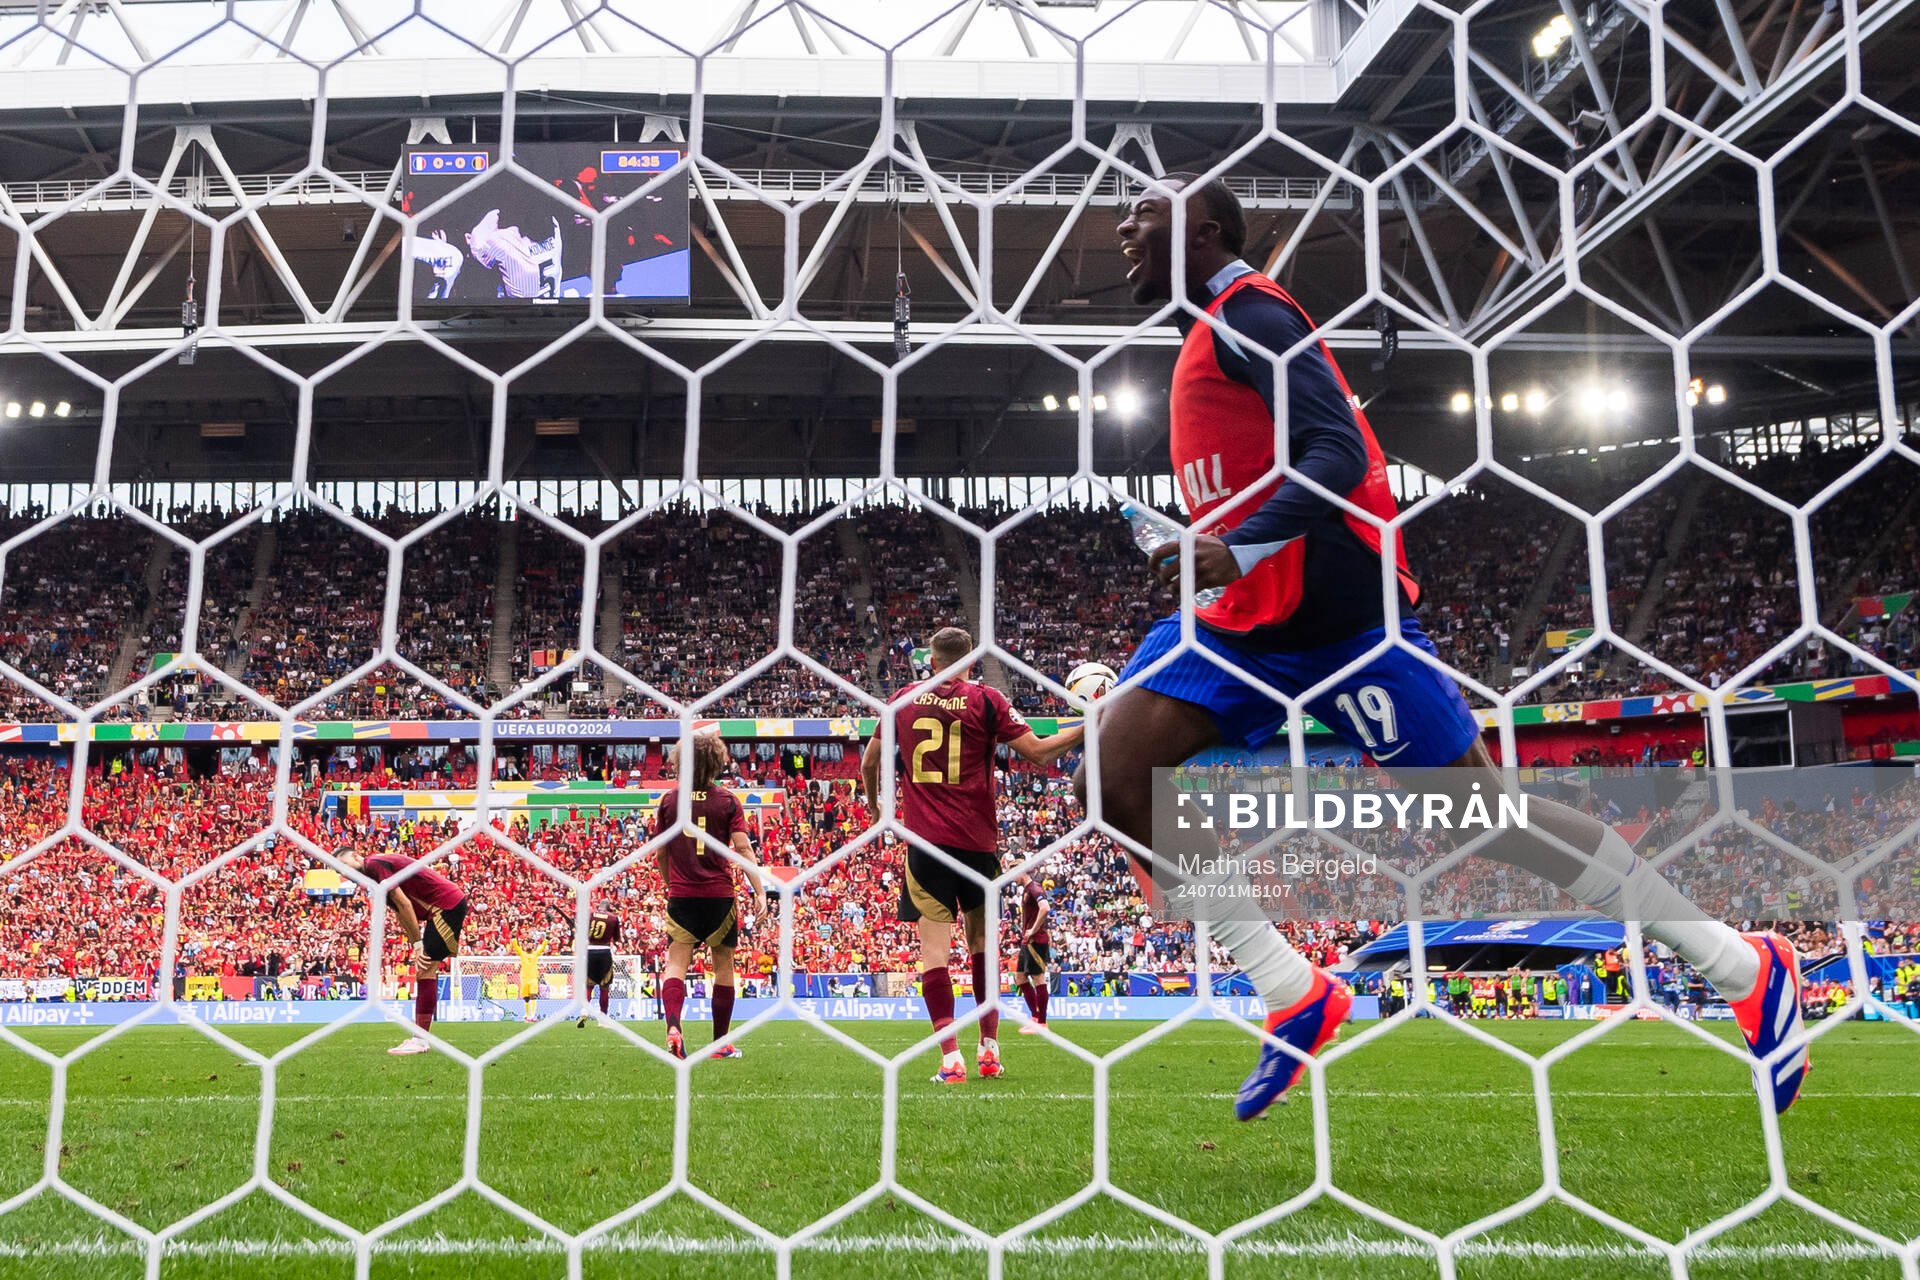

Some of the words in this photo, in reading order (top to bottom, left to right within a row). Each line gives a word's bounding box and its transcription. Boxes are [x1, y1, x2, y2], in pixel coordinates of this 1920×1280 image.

[433, 157, 443, 169] 0
[455, 157, 466, 169] 0
[618, 156, 660, 167] 84:35
[913, 692, 968, 710] CASTAGNE
[1335, 685, 1398, 747] 19
[912, 717, 961, 784] 21
